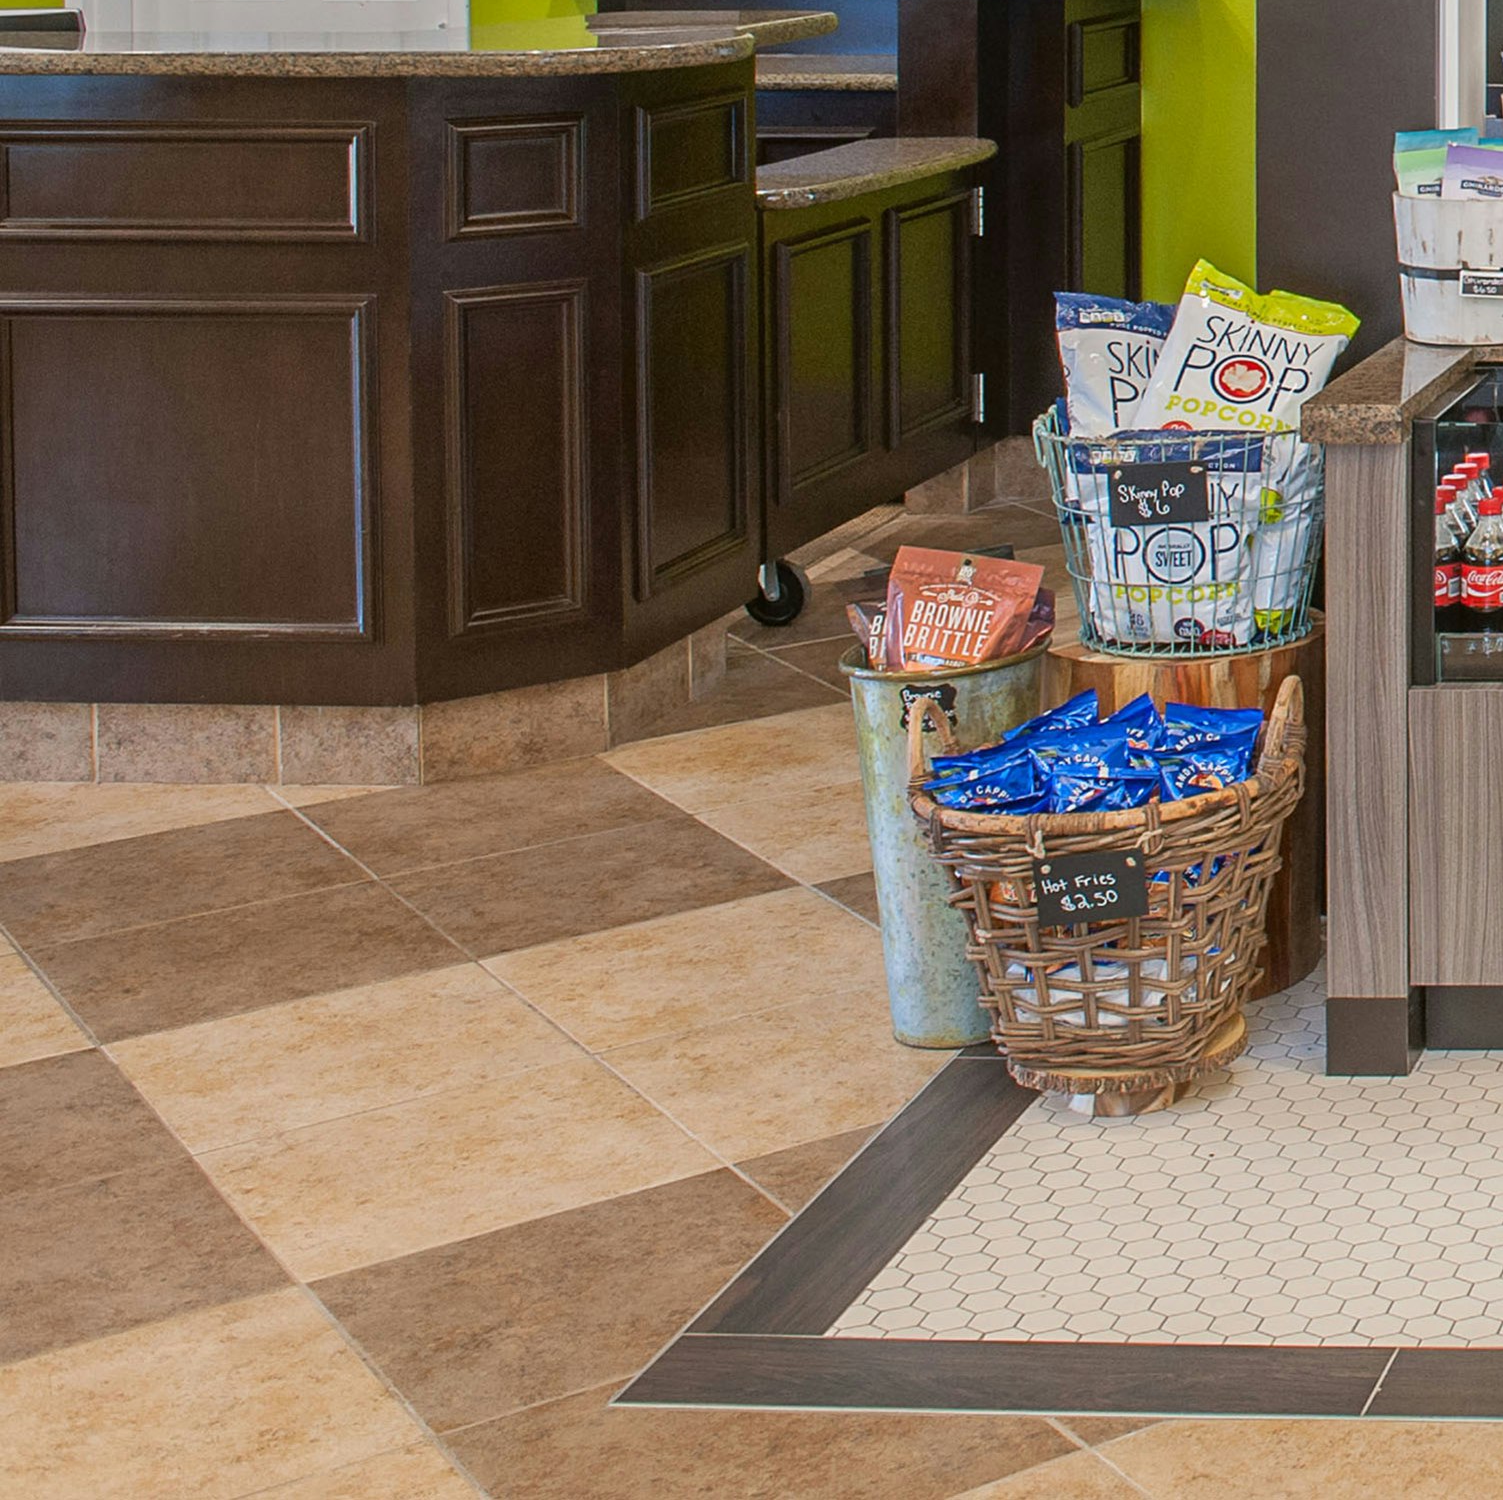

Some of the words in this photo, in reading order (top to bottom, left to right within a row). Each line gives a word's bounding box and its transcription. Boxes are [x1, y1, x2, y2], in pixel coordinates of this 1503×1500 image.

[1195, 315, 1325, 366] SKINNY
[1107, 340, 1160, 379] SKI
[1173, 343, 1311, 413] POP
[1162, 480, 1185, 499] Pop
[910, 599, 995, 635] BROWNIE
[904, 624, 989, 658] BRITTLE
[1040, 878, 1068, 895] Hot
[1075, 873, 1117, 889] Fries
[1059, 889, 1119, 912] $2.50
